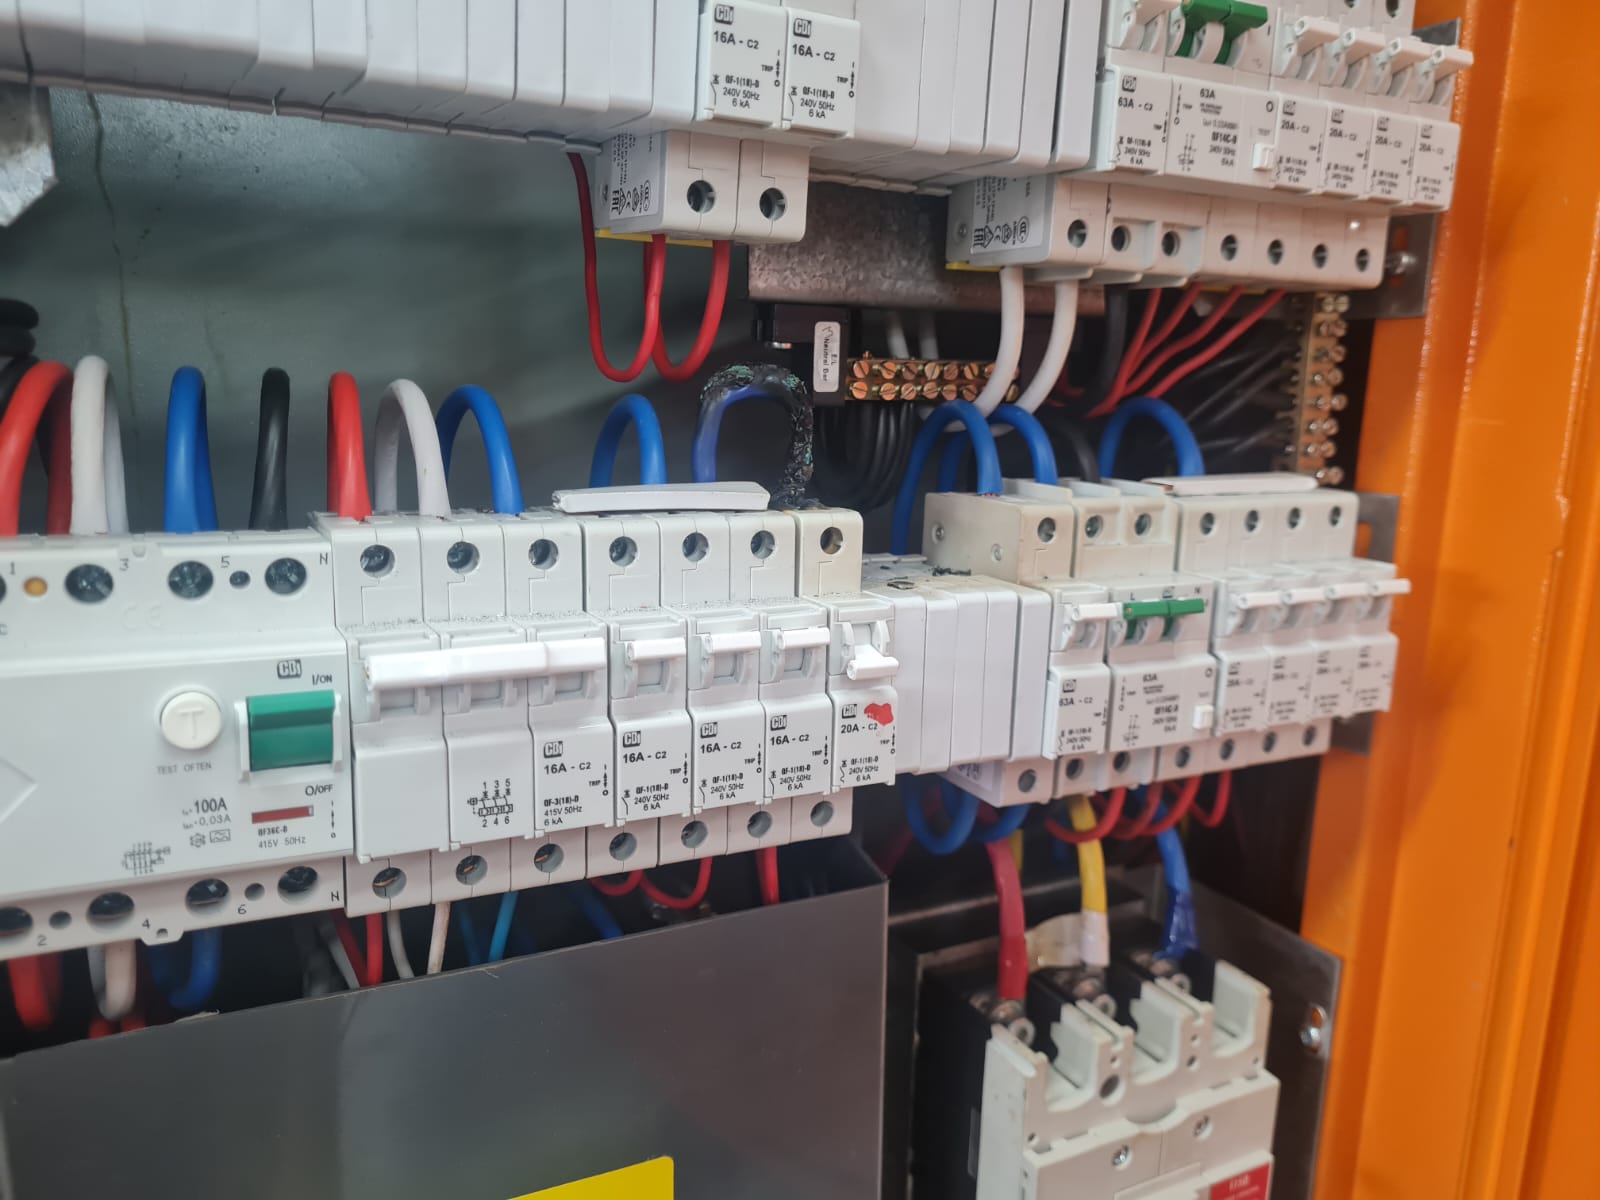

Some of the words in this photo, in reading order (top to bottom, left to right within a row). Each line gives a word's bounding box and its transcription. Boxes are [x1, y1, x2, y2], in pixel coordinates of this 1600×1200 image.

[714, 30, 736, 45] 16A
[747, 39, 760, 50] C2
[792, 43, 814, 58] 16A
[823, 51, 836, 61] C2
[761, 64, 774, 72] TRIP
[836, 75, 848, 84] TRIP
[723, 87, 742, 98] 240V
[742, 90, 760, 101] 50Hz
[1200, 88, 1215, 99] 63A
[732, 97, 738, 107] 6
[740, 98, 751, 109] kA
[800, 98, 817, 109] 240V
[818, 101, 835, 111] 50Hz
[1118, 97, 1135, 109] 63A
[809, 109, 814, 118] 6
[815, 109, 826, 119] kA
[1281, 120, 1295, 130] 20A
[1329, 128, 1343, 138] 20A
[1375, 135, 1388, 146] 20A
[120, 558, 129, 571] 3
[220, 556, 230, 568] 5
[319, 553, 329, 566] N
[840, 723, 860, 734] 20A
[868, 722, 878, 730] C2
[770, 736, 790, 746] 16A
[799, 734, 810, 742] C2
[700, 743, 721, 754] 16A
[730, 741, 742, 750] C2
[623, 752, 644, 764] 16A
[655, 751, 667, 760] C2
[744, 757, 756, 765] TRIP
[157, 765, 178, 775] TEST
[184, 761, 212, 772] OFTEN
[544, 762, 567, 775] 16A
[579, 761, 591, 770] C2
[669, 767, 682, 775] TRIP
[849, 766, 864, 776] 240V
[864, 764, 879, 773] 50Hz
[494, 780, 500, 788] 3
[505, 778, 511, 787] 5
[779, 776, 796, 786] 240V
[796, 774, 812, 783] 50Hz
[856, 775, 861, 783] 6
[862, 773, 871, 782] kA
[710, 784, 727, 794] 240V
[727, 782, 744, 792] 50Hz
[787, 783, 793, 791] 6
[793, 782, 804, 790] kA
[634, 795, 652, 806] 240V
[652, 793, 670, 803] 50Hz
[719, 792, 725, 800] 6
[726, 791, 736, 799] kA
[195, 797, 228, 814] 100A
[544, 807, 563, 817] 415V
[564, 805, 583, 815] 50Hz
[643, 803, 649, 811] 6
[650, 802, 661, 811] kA
[482, 819, 488, 828] 2
[493, 817, 499, 826] 4
[504, 816, 510, 825] 6
[552, 817, 563, 825] kA
[258, 839, 279, 849] 415V
[330, 891, 341, 903] N
[237, 904, 248, 916] 6
[142, 918, 151, 930] 4
[37, 934, 47, 947] 2
